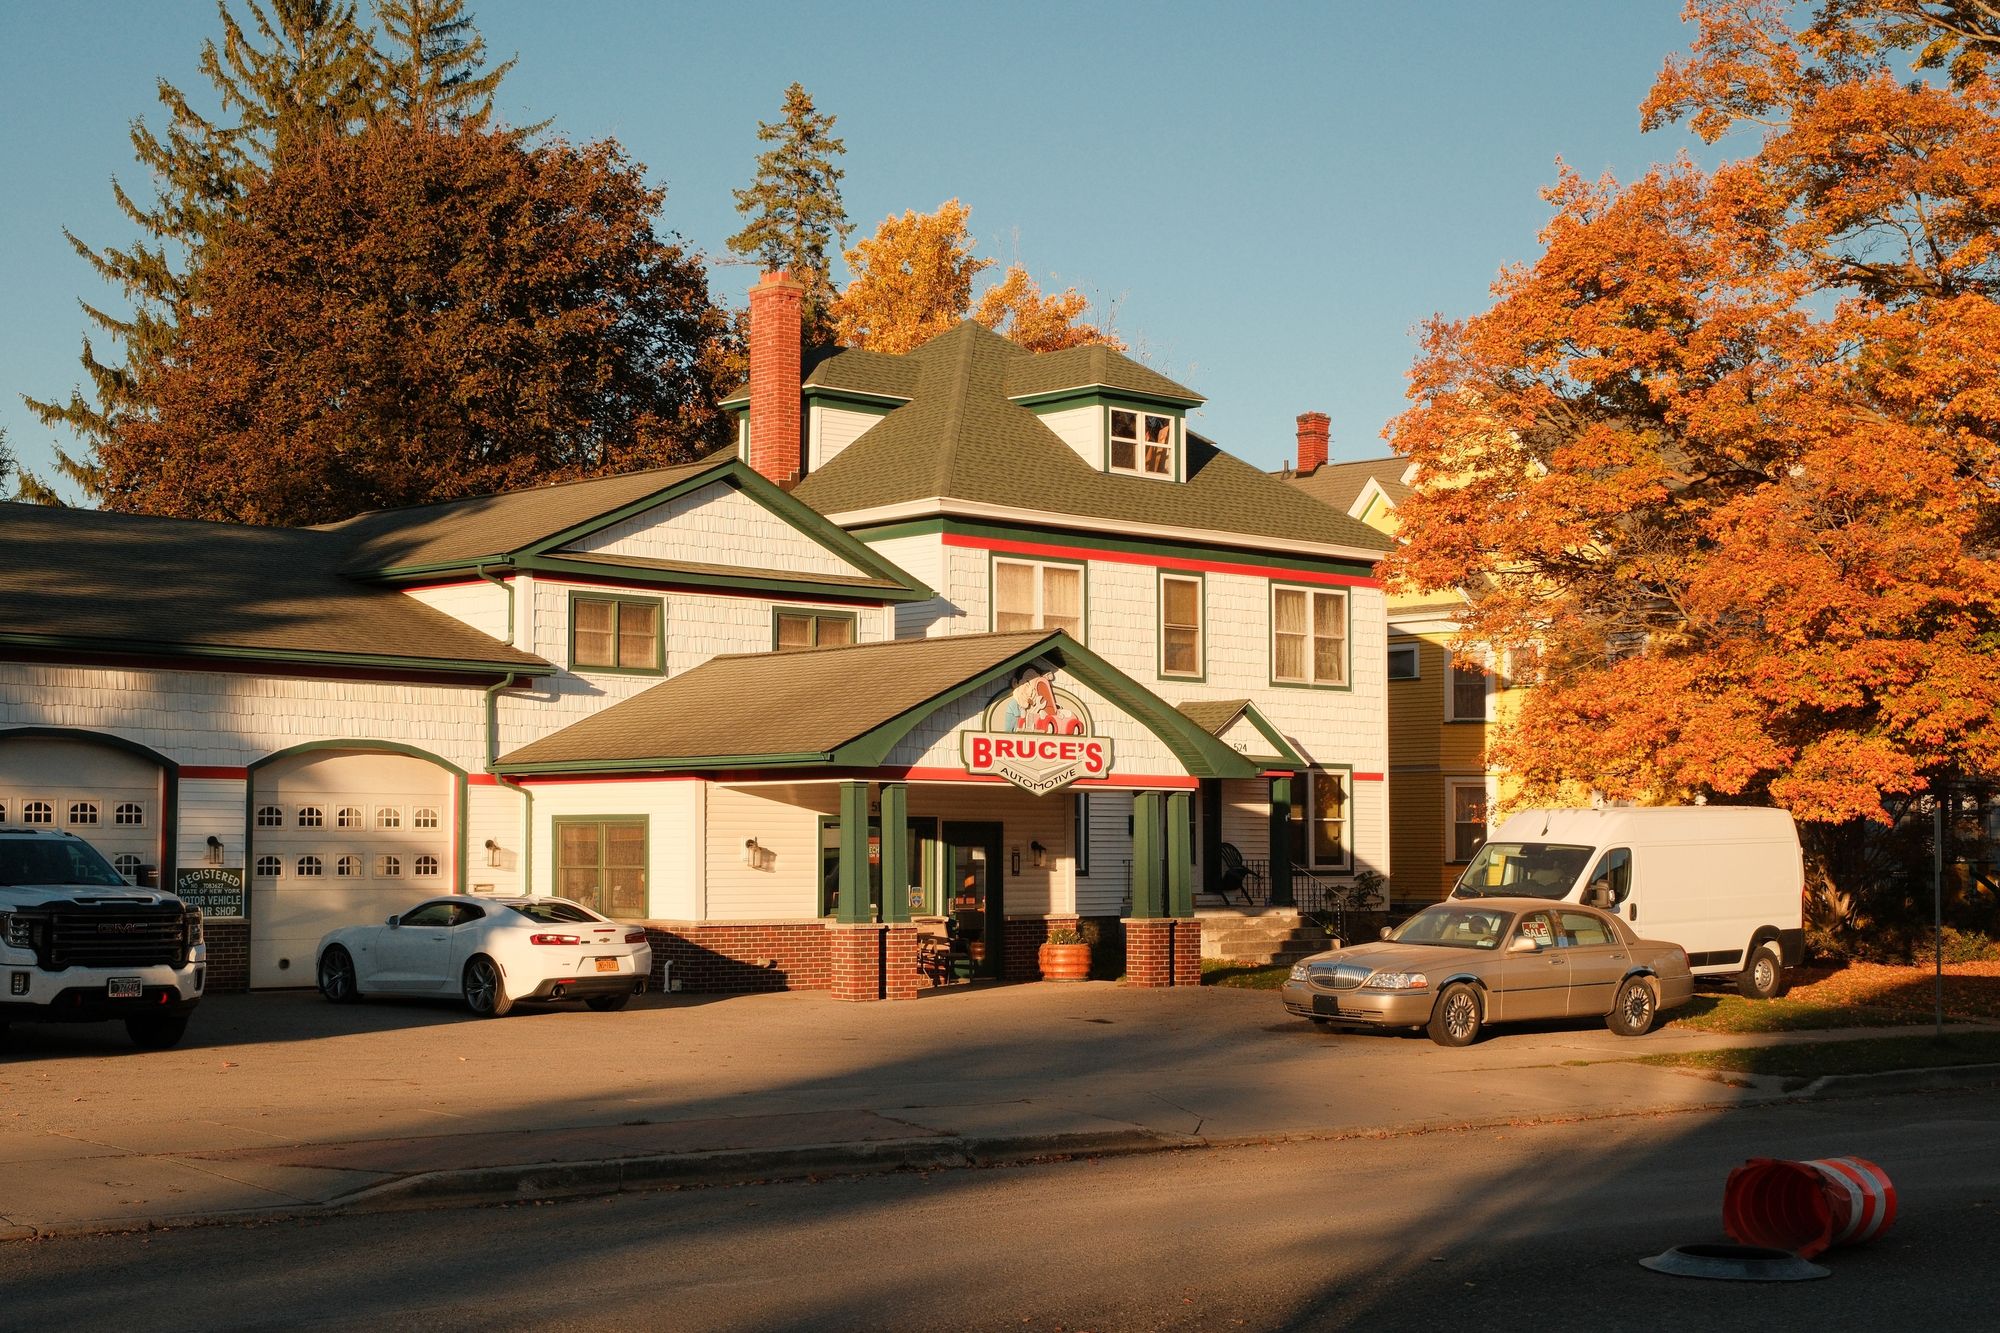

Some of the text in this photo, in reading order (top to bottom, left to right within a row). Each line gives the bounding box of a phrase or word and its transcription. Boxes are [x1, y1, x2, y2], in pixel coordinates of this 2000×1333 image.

[1233, 742, 1247, 752] 524
[973, 737, 1103, 773] BRUCE'S
[1000, 767, 1076, 790] AUTOMOTIVE
[179, 869, 240, 888] REGISTERED
[208, 895, 241, 905] VEHICLE
[215, 906, 237, 916] SHOP
[1524, 928, 1548, 938] SALE
